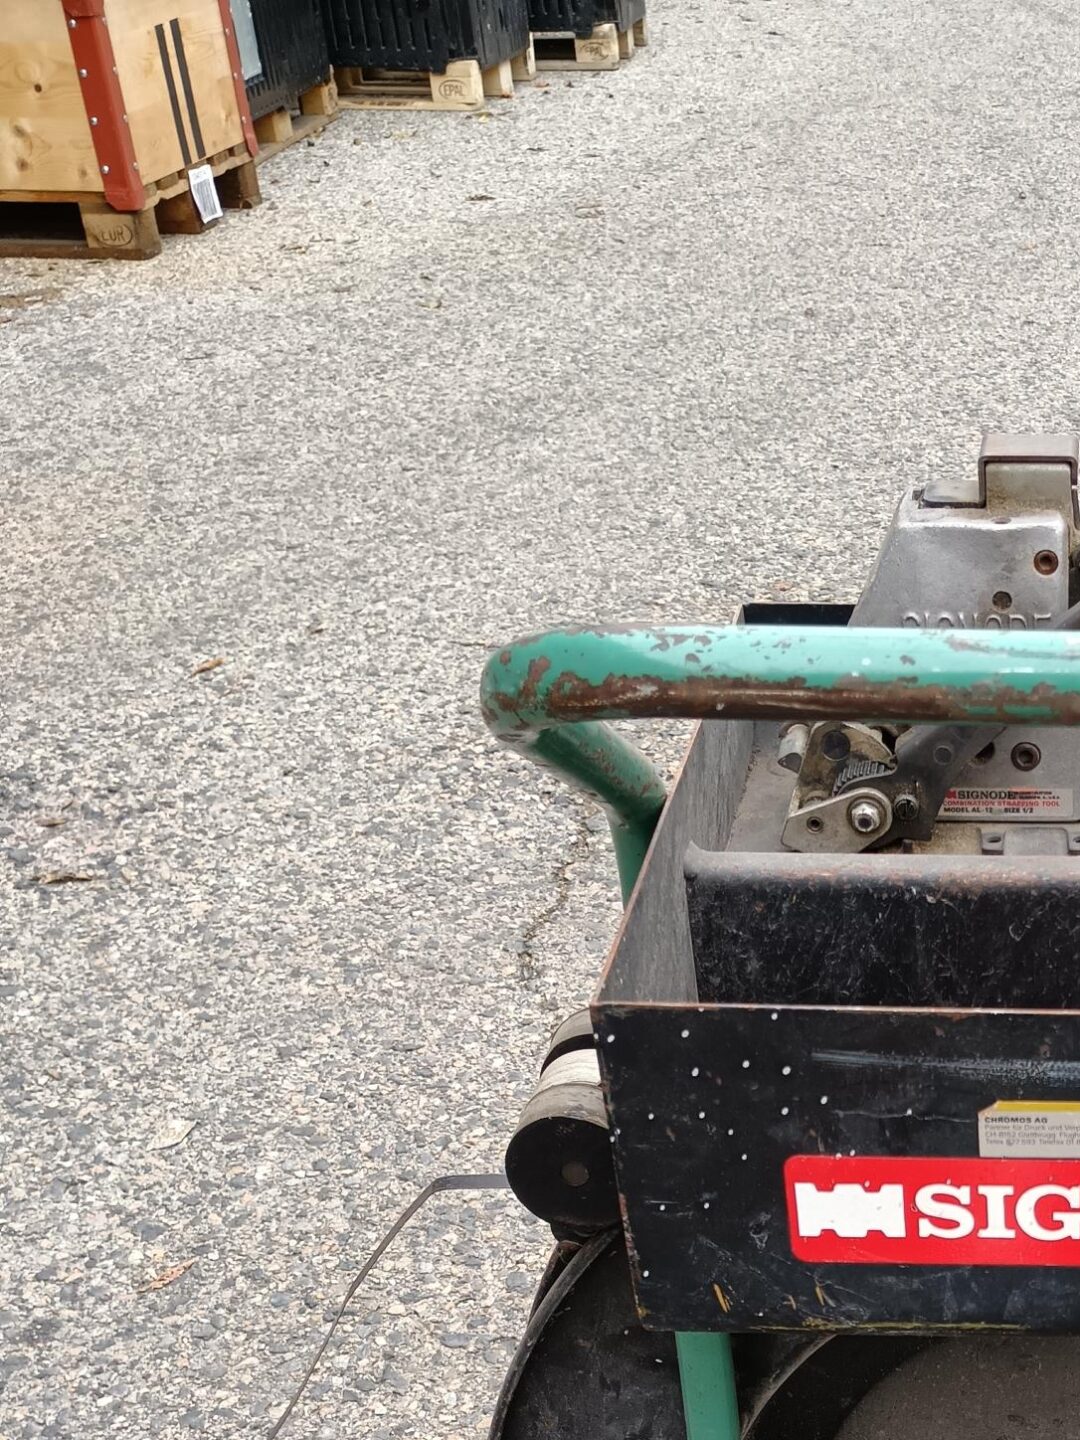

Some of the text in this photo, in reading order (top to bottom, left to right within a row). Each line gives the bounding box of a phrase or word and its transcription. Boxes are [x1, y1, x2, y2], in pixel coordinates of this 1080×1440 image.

[957, 790, 1016, 800] SIGNODE
[984, 1116, 1048, 1124] CHROMOS AG
